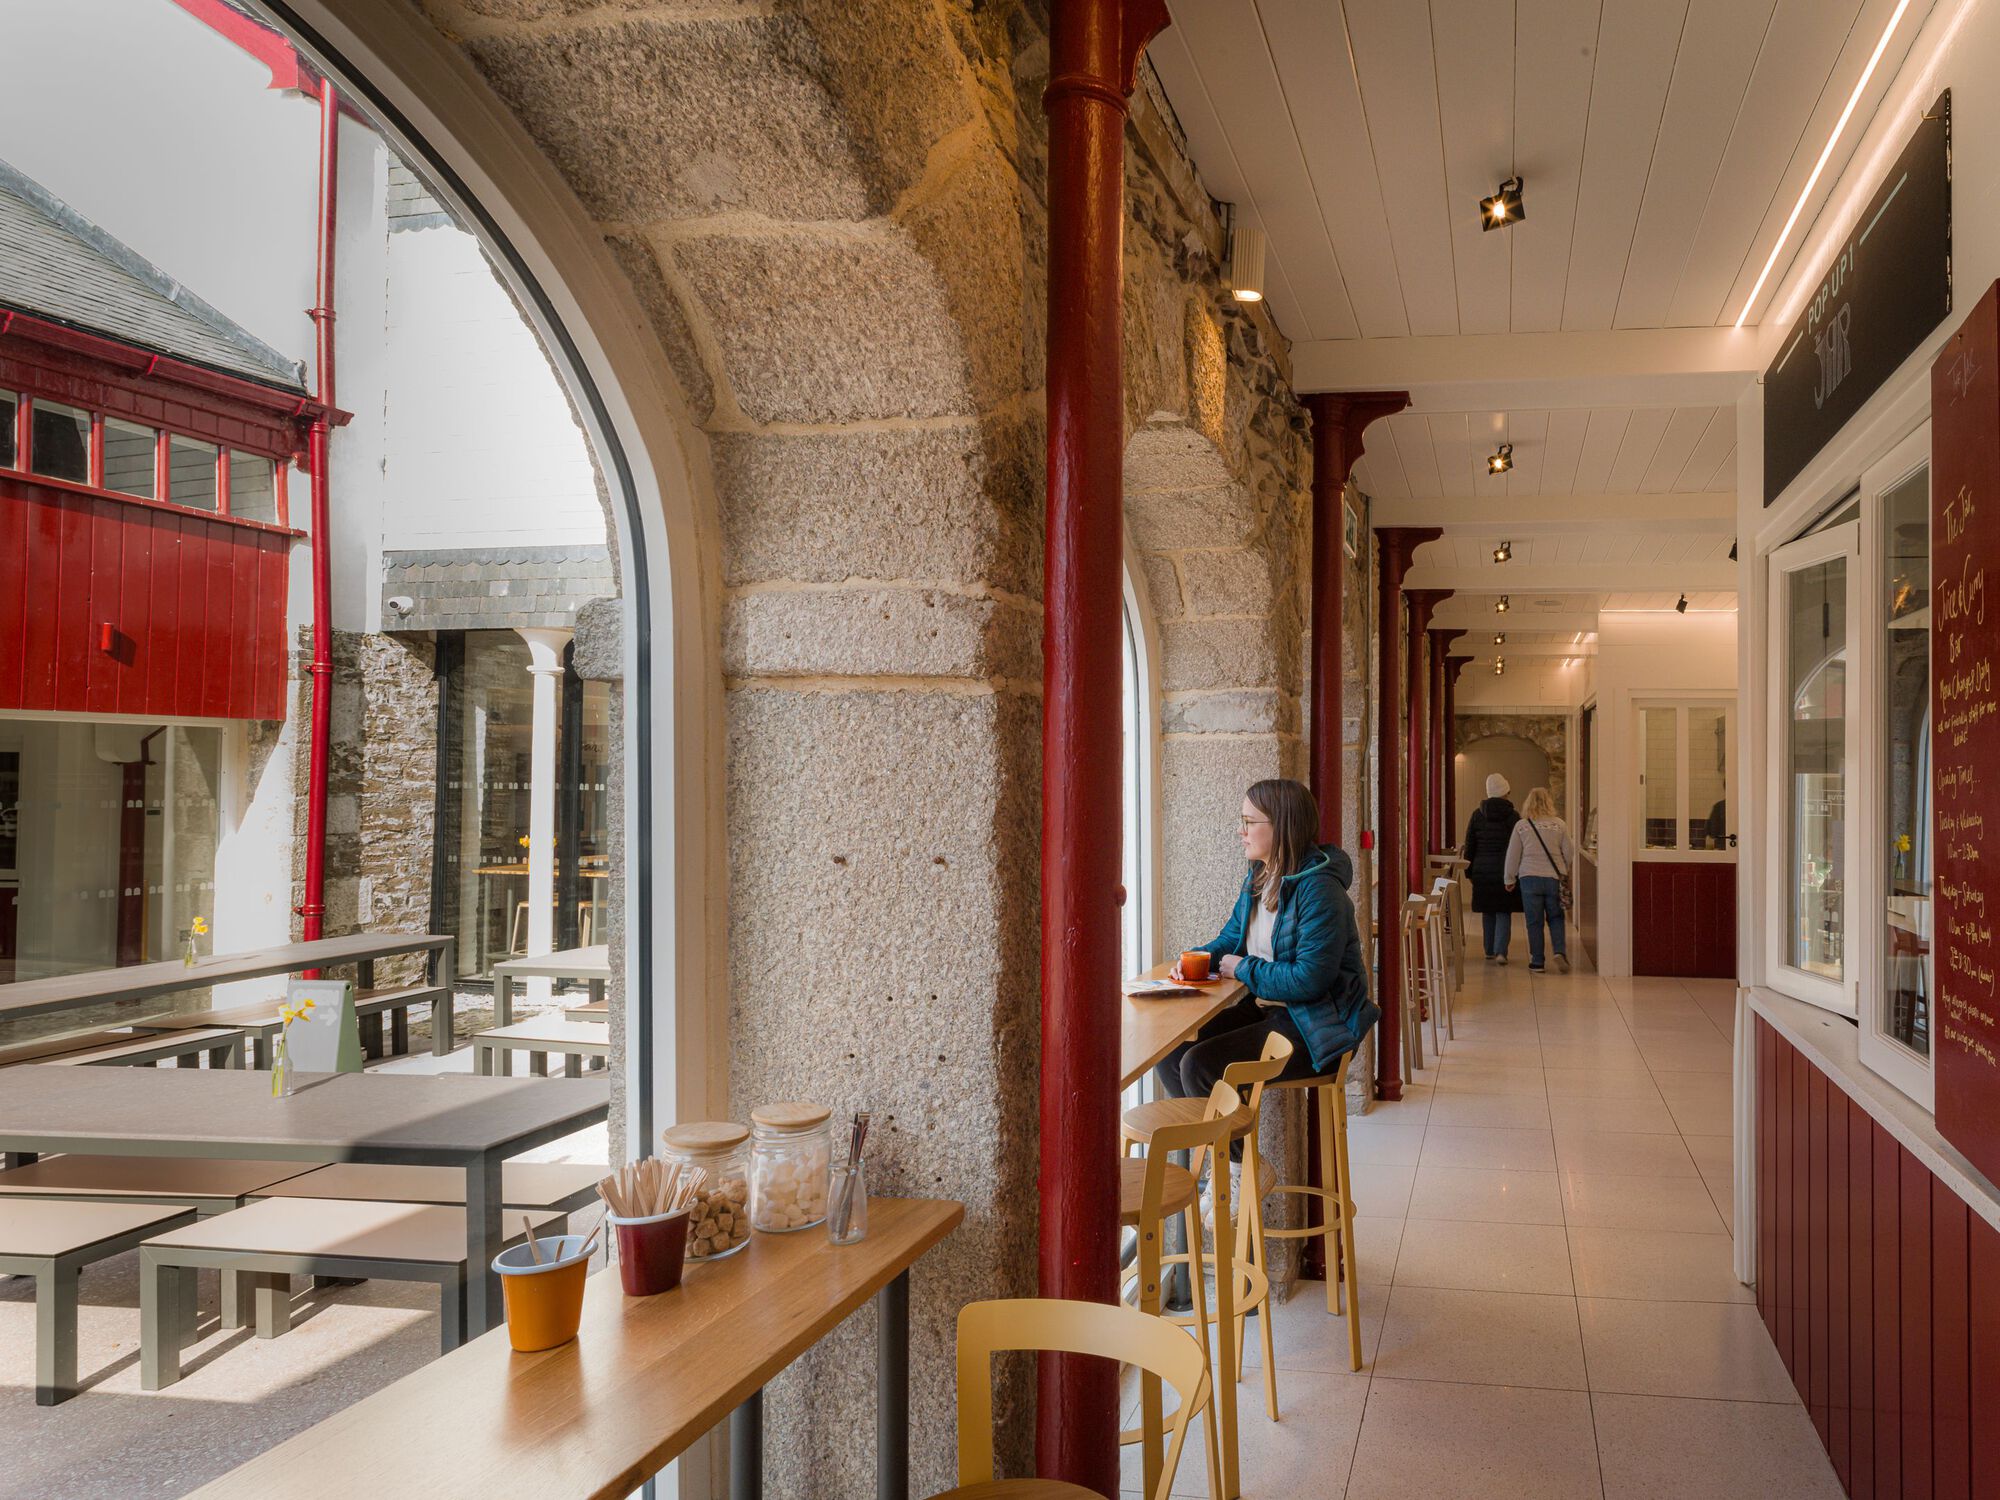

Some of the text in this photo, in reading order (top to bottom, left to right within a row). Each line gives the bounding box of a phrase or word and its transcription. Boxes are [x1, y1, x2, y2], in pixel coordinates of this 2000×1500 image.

[1808, 243, 1854, 334] POP UP 1
[1942, 500, 1958, 544] The
[1963, 554, 1984, 625] Curry
[1949, 632, 1963, 663] Bar
[1952, 669, 1975, 701] Changes
[1975, 657, 1990, 692] Daily
[1937, 766, 1957, 800] Opening
